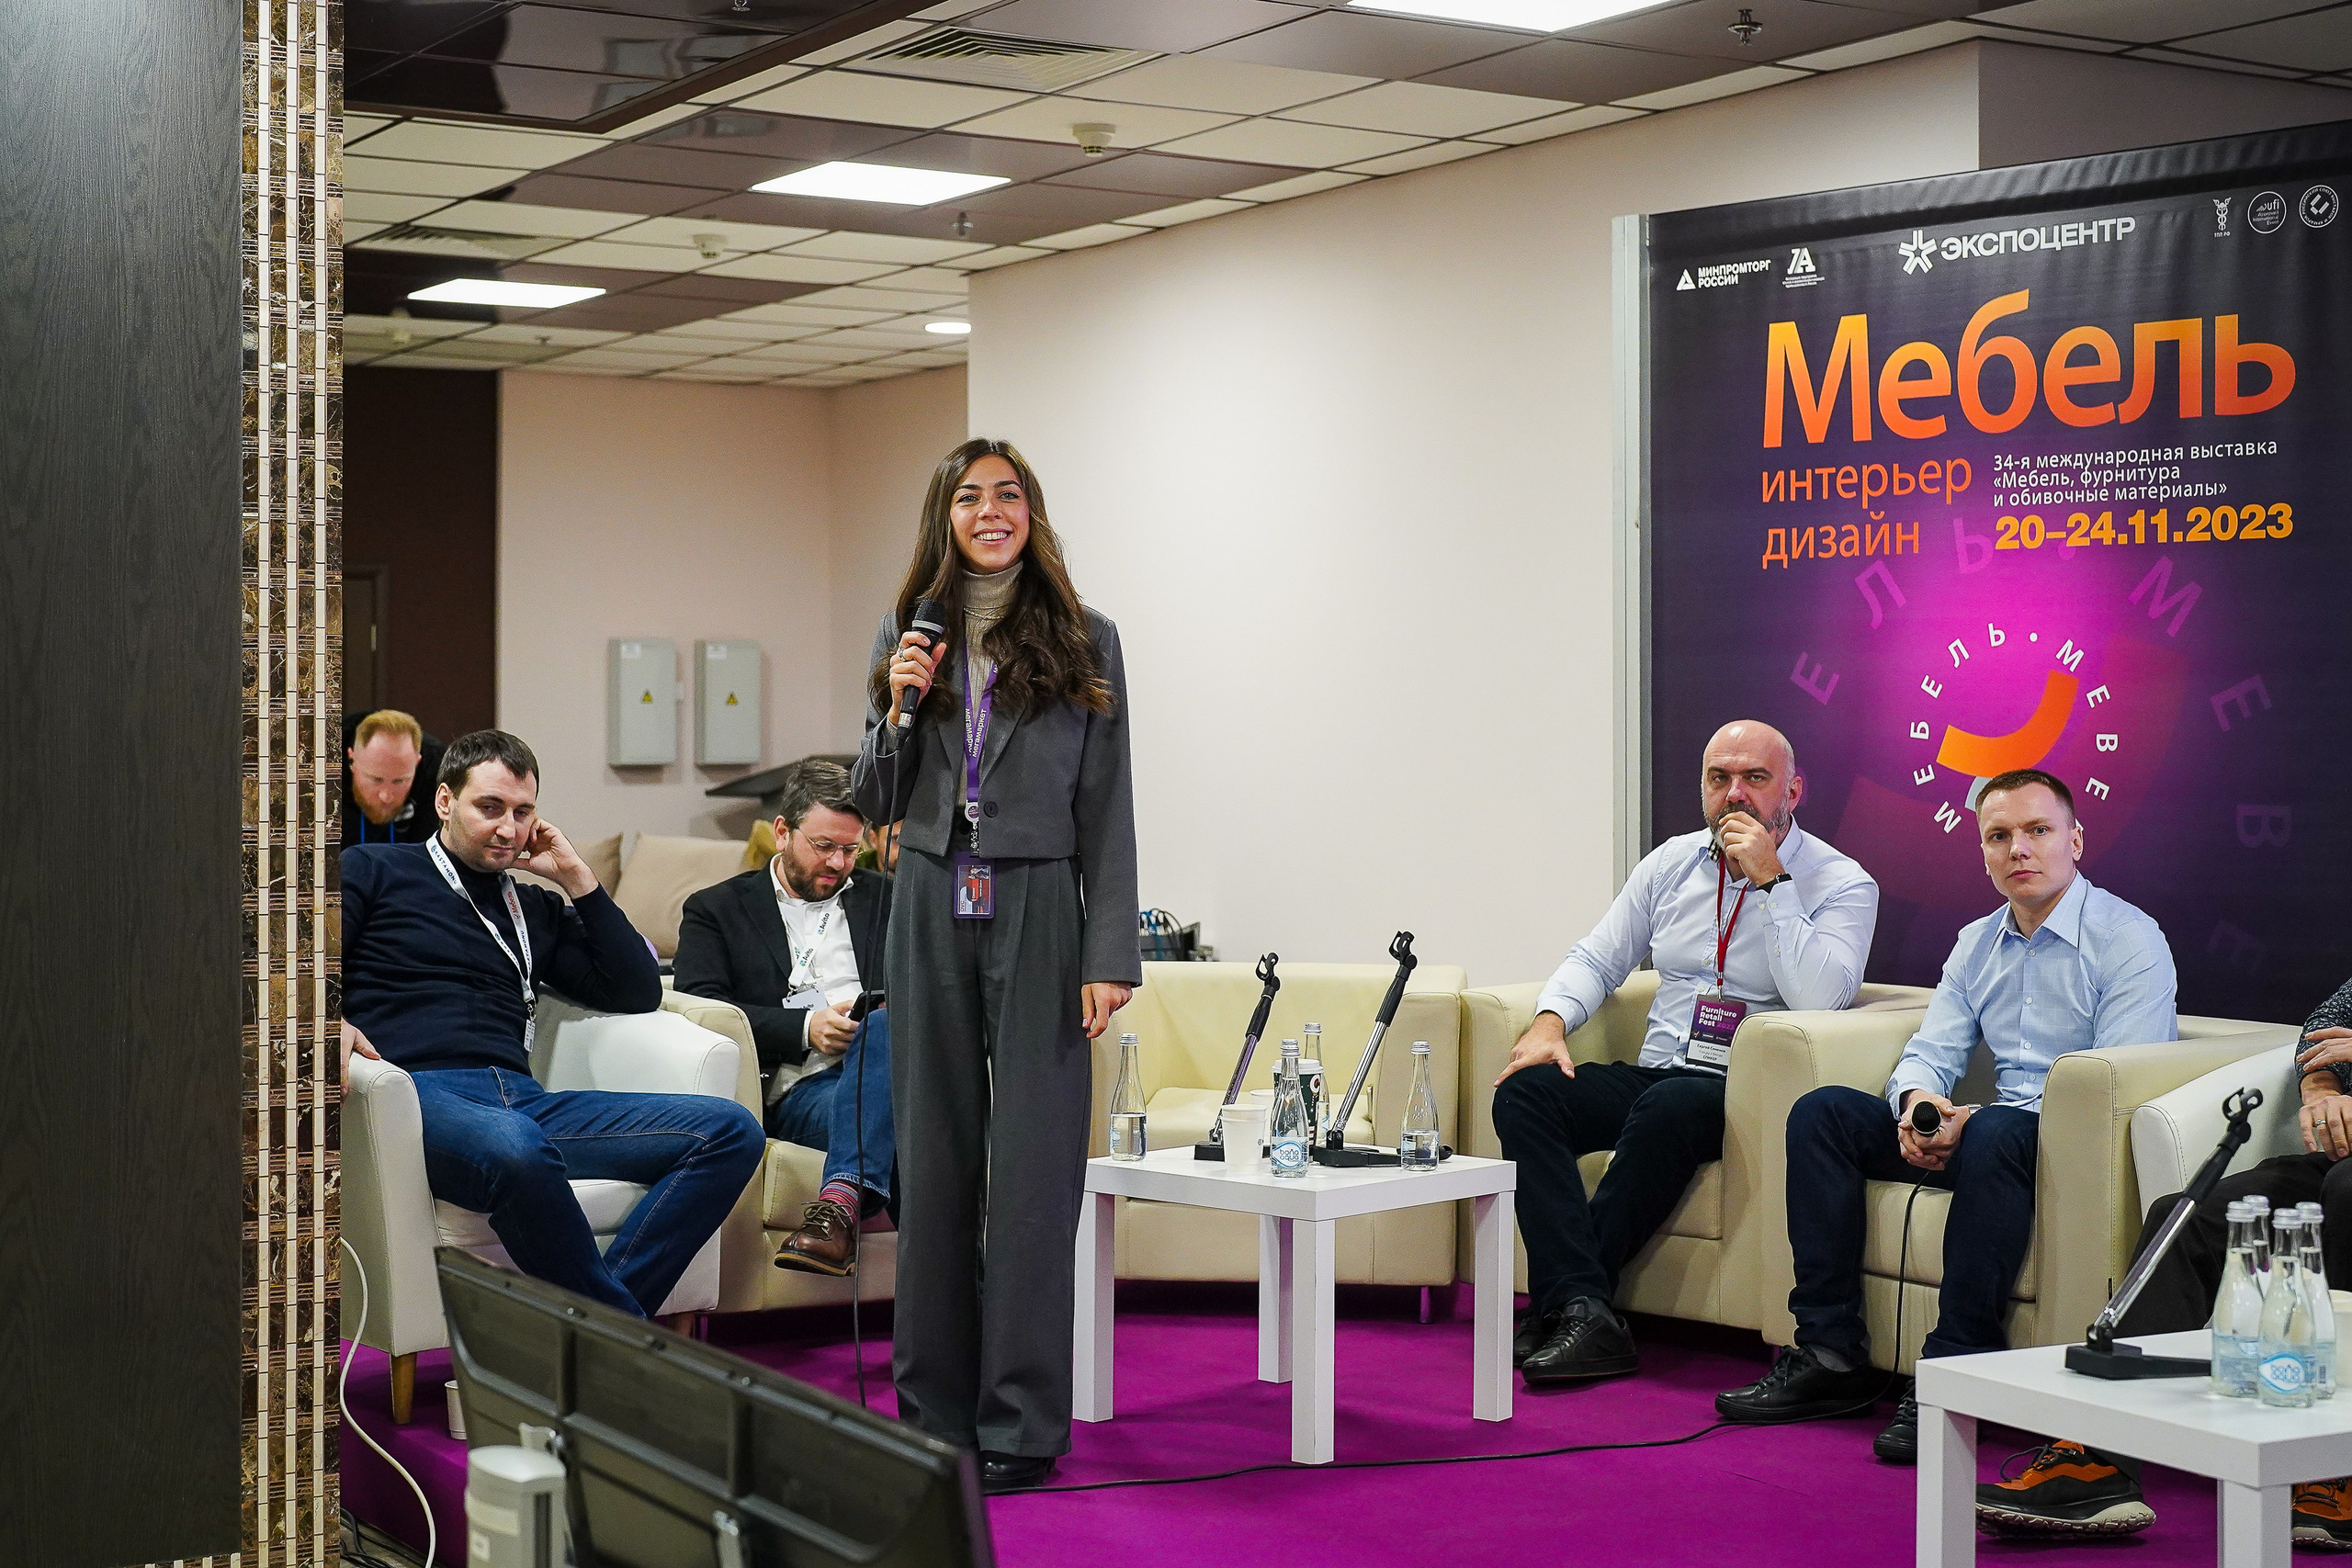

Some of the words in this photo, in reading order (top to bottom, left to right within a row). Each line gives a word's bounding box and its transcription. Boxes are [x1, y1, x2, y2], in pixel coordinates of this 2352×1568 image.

[2267, 198, 2279, 211] ufi
[1940, 216, 2136, 261] ЭКСПОЦЕНТР
[1698, 259, 1771, 277] МИНПРОМТОРГ
[1698, 274, 1739, 288] РОССИИ
[1763, 288, 2297, 449] Мебель
[1993, 454, 2030, 471] 34-я
[2036, 445, 2184, 472] международная
[2190, 441, 2278, 459] выставка
[1762, 458, 1973, 509] интерьер
[1993, 468, 2075, 489] «Мебель,
[2080, 466, 2180, 489] фурнитура
[1994, 495, 2004, 507] и
[2009, 487, 2109, 506] обивочные
[2115, 480, 2227, 502] материалы»
[1762, 511, 1919, 570] дизайн
[965, 708, 974, 757] мегамарк
[972, 708, 987, 758] мегамаркет
[820, 912, 831, 930] Avito
[802, 947, 814, 962] Avito
[1700, 1011, 1723, 1022] Retail
[1701, 1005, 1737, 1019] Furniture
